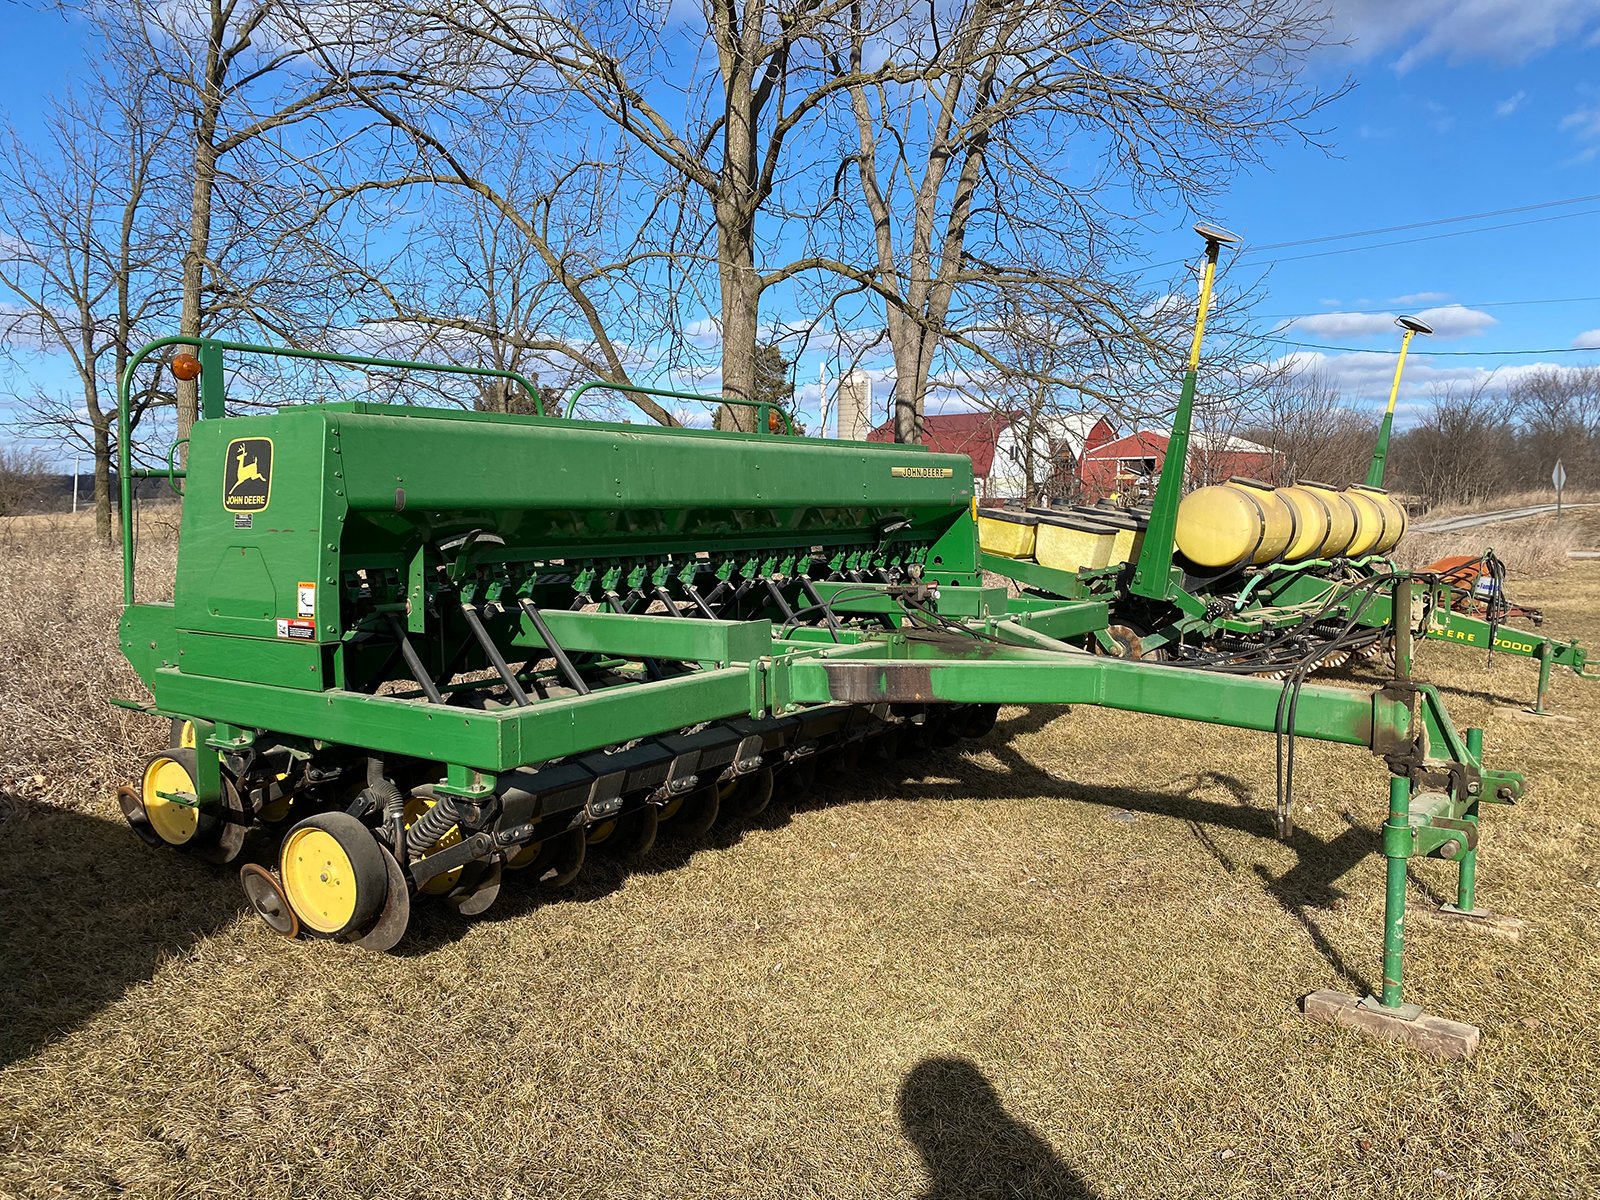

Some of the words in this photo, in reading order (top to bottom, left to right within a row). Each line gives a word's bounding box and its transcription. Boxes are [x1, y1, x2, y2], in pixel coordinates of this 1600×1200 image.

[903, 468, 922, 477] JOHN
[923, 468, 944, 477] DEERE
[226, 495, 243, 505] JOHN
[244, 495, 266, 505] DEERE
[1493, 639, 1533, 653] 7000
